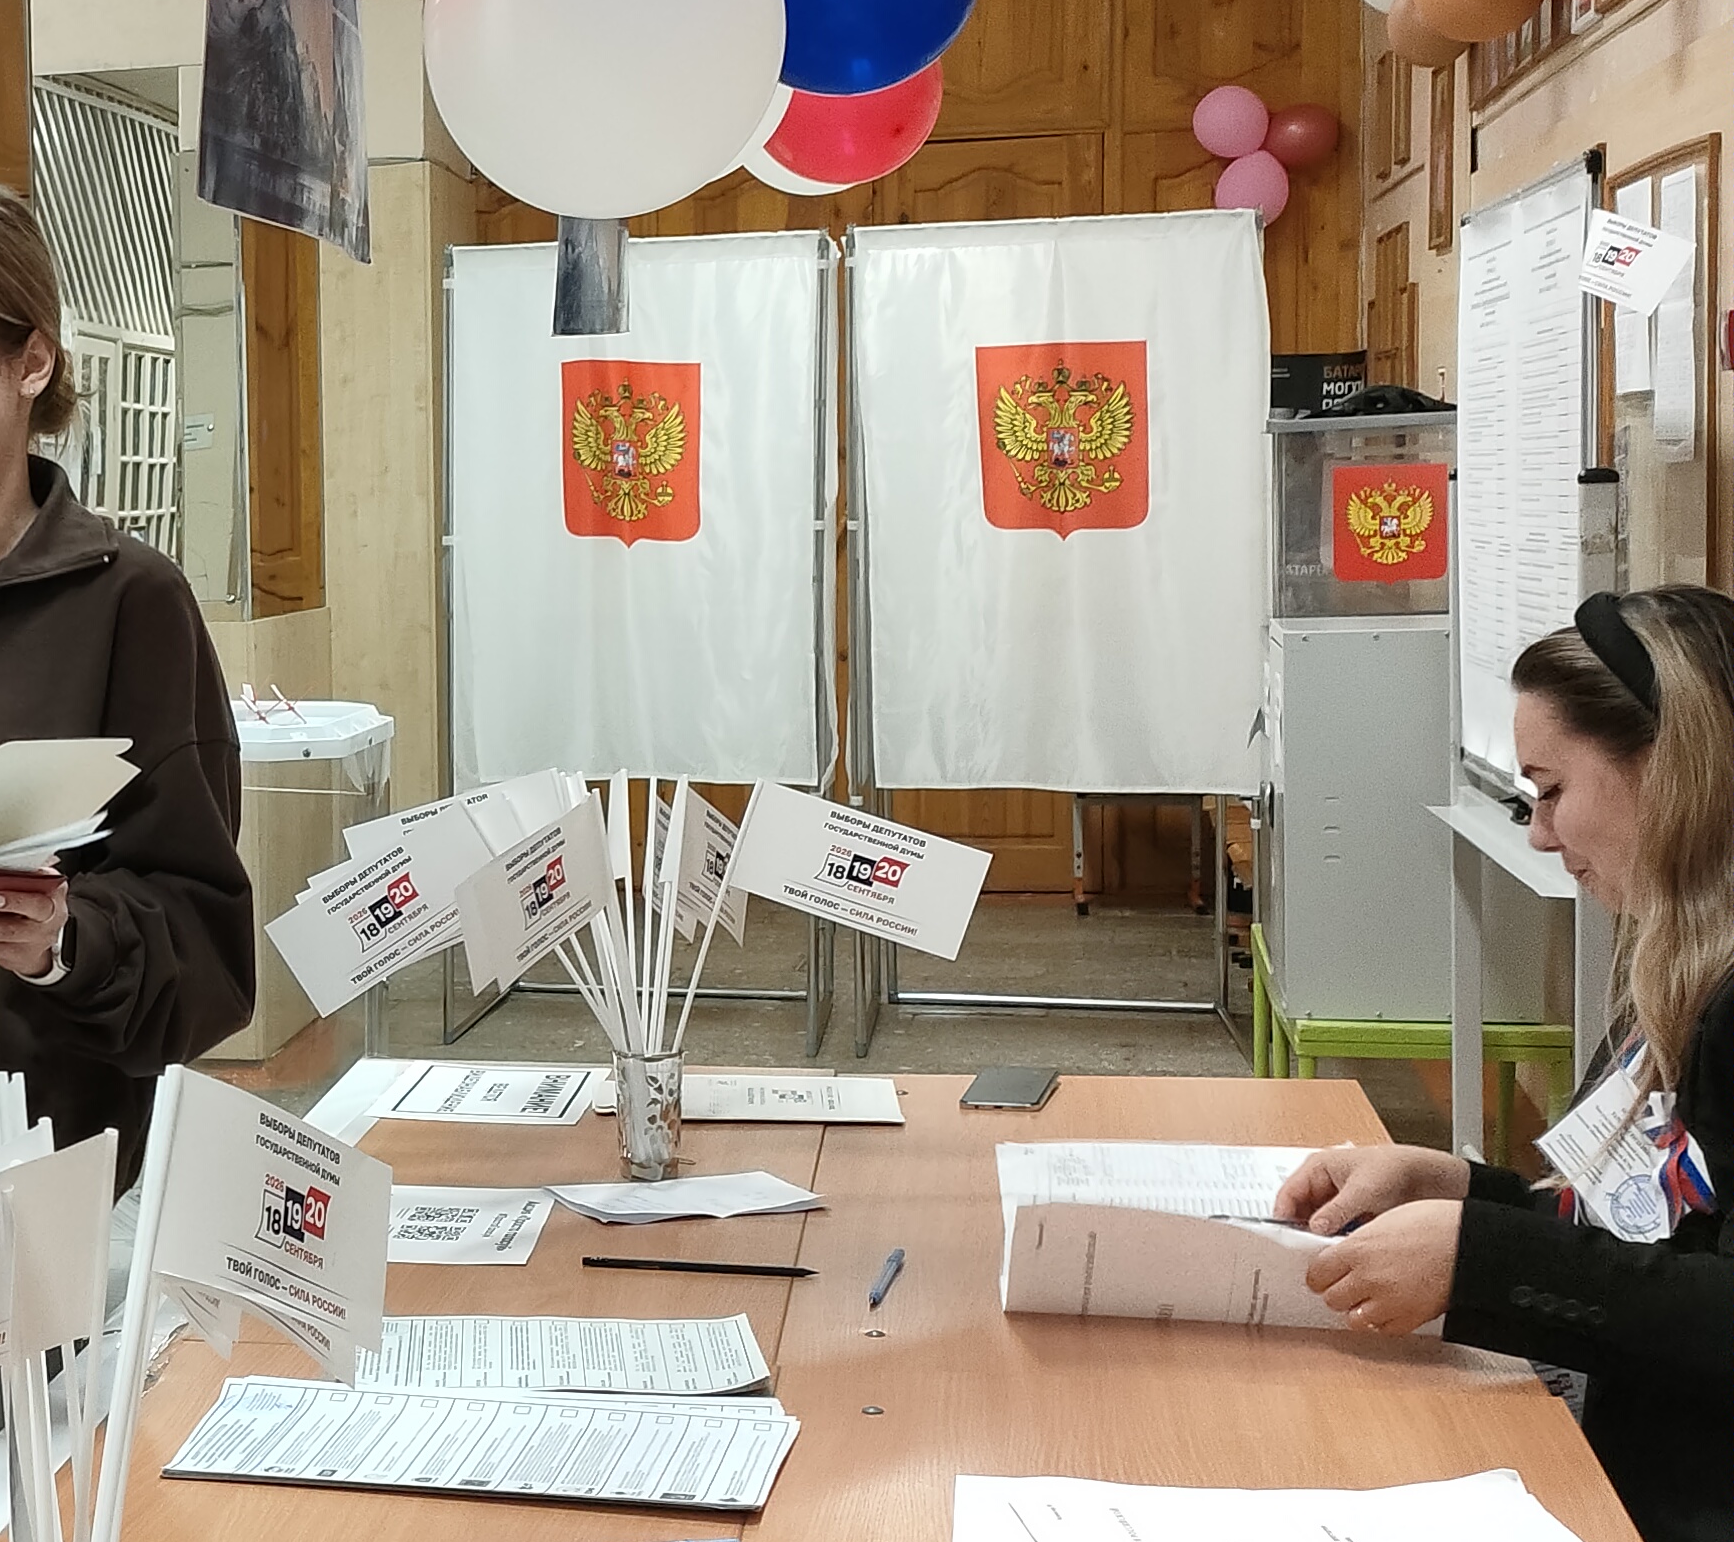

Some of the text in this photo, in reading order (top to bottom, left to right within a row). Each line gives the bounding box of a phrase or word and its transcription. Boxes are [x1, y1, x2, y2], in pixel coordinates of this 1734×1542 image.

[1606, 250, 1617, 261] 19
[1620, 250, 1636, 262] 20
[400, 808, 438, 826] ВЫБОРЫ
[830, 810, 927, 848] ВЫБОРЫ ДЕПУТАТОВ
[505, 827, 562, 871] ВЫБОРЫ ДЕПУТАТОВ
[824, 822, 924, 860] ГОСУДАРСТВЕННОЙ ДУМЫ
[322, 847, 404, 904] ВЫБОРЫ ДЕПУТАТОВ
[327, 856, 412, 915] ГОСУДАРСТВЕННОЙ ДУМЫ
[525, 863, 563, 917] 18 19 20
[826, 861, 902, 881] 18 19 20
[360, 882, 412, 942] 18 19 20
[783, 885, 918, 937] ТВОЙ ГОЛОС СИЛА РОССИИ!
[847, 884, 895, 905] СЕНТЯБРЯ
[388, 903, 428, 934] СЕНТЯБРЯ
[351, 930, 431, 985] ТВОЙ ГОЛОС СИЛА
[260, 1112, 340, 1164] ВЫБОРЫ ДЕПУТАТОВ
[255, 1134, 340, 1187] ГОСУДАРСТВЕННОЙ ДУМЫ
[265, 1173, 284, 1191] 2026
[265, 1197, 325, 1235] 18 19 20
[284, 1240, 324, 1269] СЕНТЯБРЯ
[226, 1256, 346, 1320] ТВОЙ ГОЛОС СИЛА РОССИИ!
